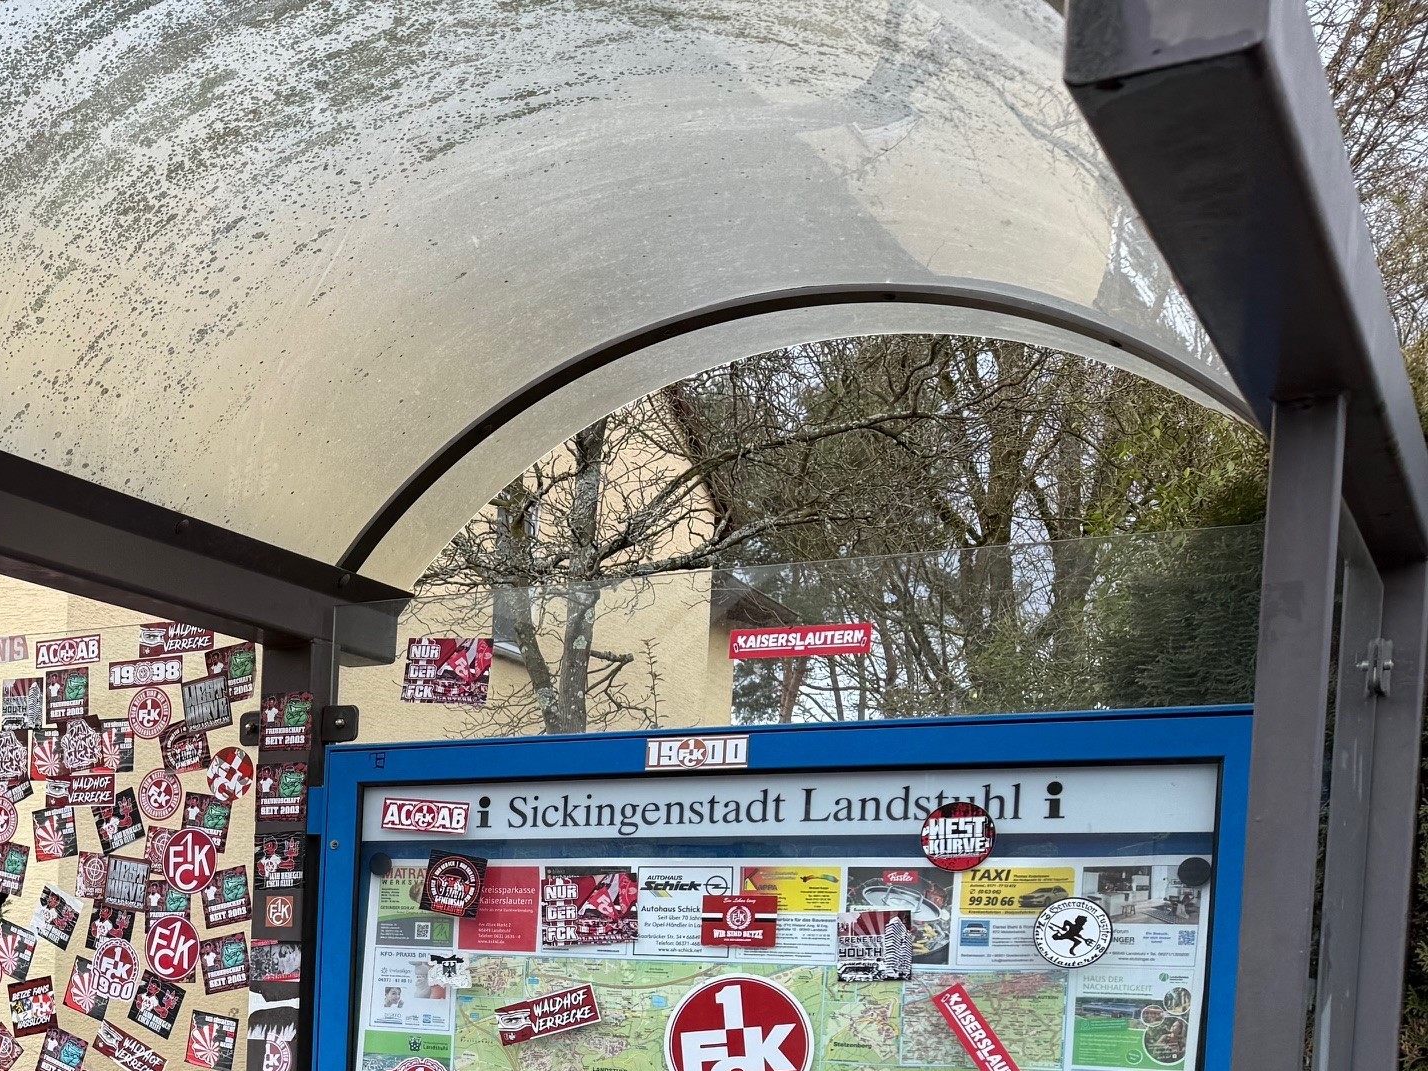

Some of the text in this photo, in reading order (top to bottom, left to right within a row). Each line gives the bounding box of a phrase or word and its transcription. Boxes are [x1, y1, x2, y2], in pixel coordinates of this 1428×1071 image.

[736, 629, 865, 652] KAISERSLAUTERN
[410, 644, 439, 659] NUR
[409, 664, 436, 680] DER
[405, 684, 434, 699] FCK
[50, 707, 84, 717] SEIT 2003
[265, 736, 305, 745] SEIT 2003
[72, 777, 110, 792] WALDHOF
[68, 790, 113, 804] VERRECKE
[801, 784, 1021, 822] Landsthl
[261, 806, 300, 815] SEIT 2003
[508, 788, 786, 835] Sickingenstadt
[929, 817, 986, 838] WEST
[929, 838, 986, 854] KURVE
[888, 872, 913, 882] Fissler
[970, 869, 1011, 881] TAXI
[2, 880, 18, 889] 2003
[640, 881, 701, 890] Schick
[545, 886, 577, 899] NUR
[479, 897, 532, 905] Kaiserslautern
[969, 897, 1015, 906] 99 30 66
[209, 907, 246, 922] SEIT 2003
[548, 907, 576, 920] DER
[548, 927, 577, 940] FCK
[714, 929, 763, 939] WIR SIND BETZE
[839, 948, 882, 957] YOUTH
[92, 971, 134, 1000] 1900
[1082, 983, 1152, 992] NACHHALTIGKEIT
[12, 985, 49, 1001] BETZE FANS
[533, 990, 588, 1017] WALDHOF
[531, 1006, 594, 1032] VERRECKE
[123, 1036, 162, 1068] WALDHOF
